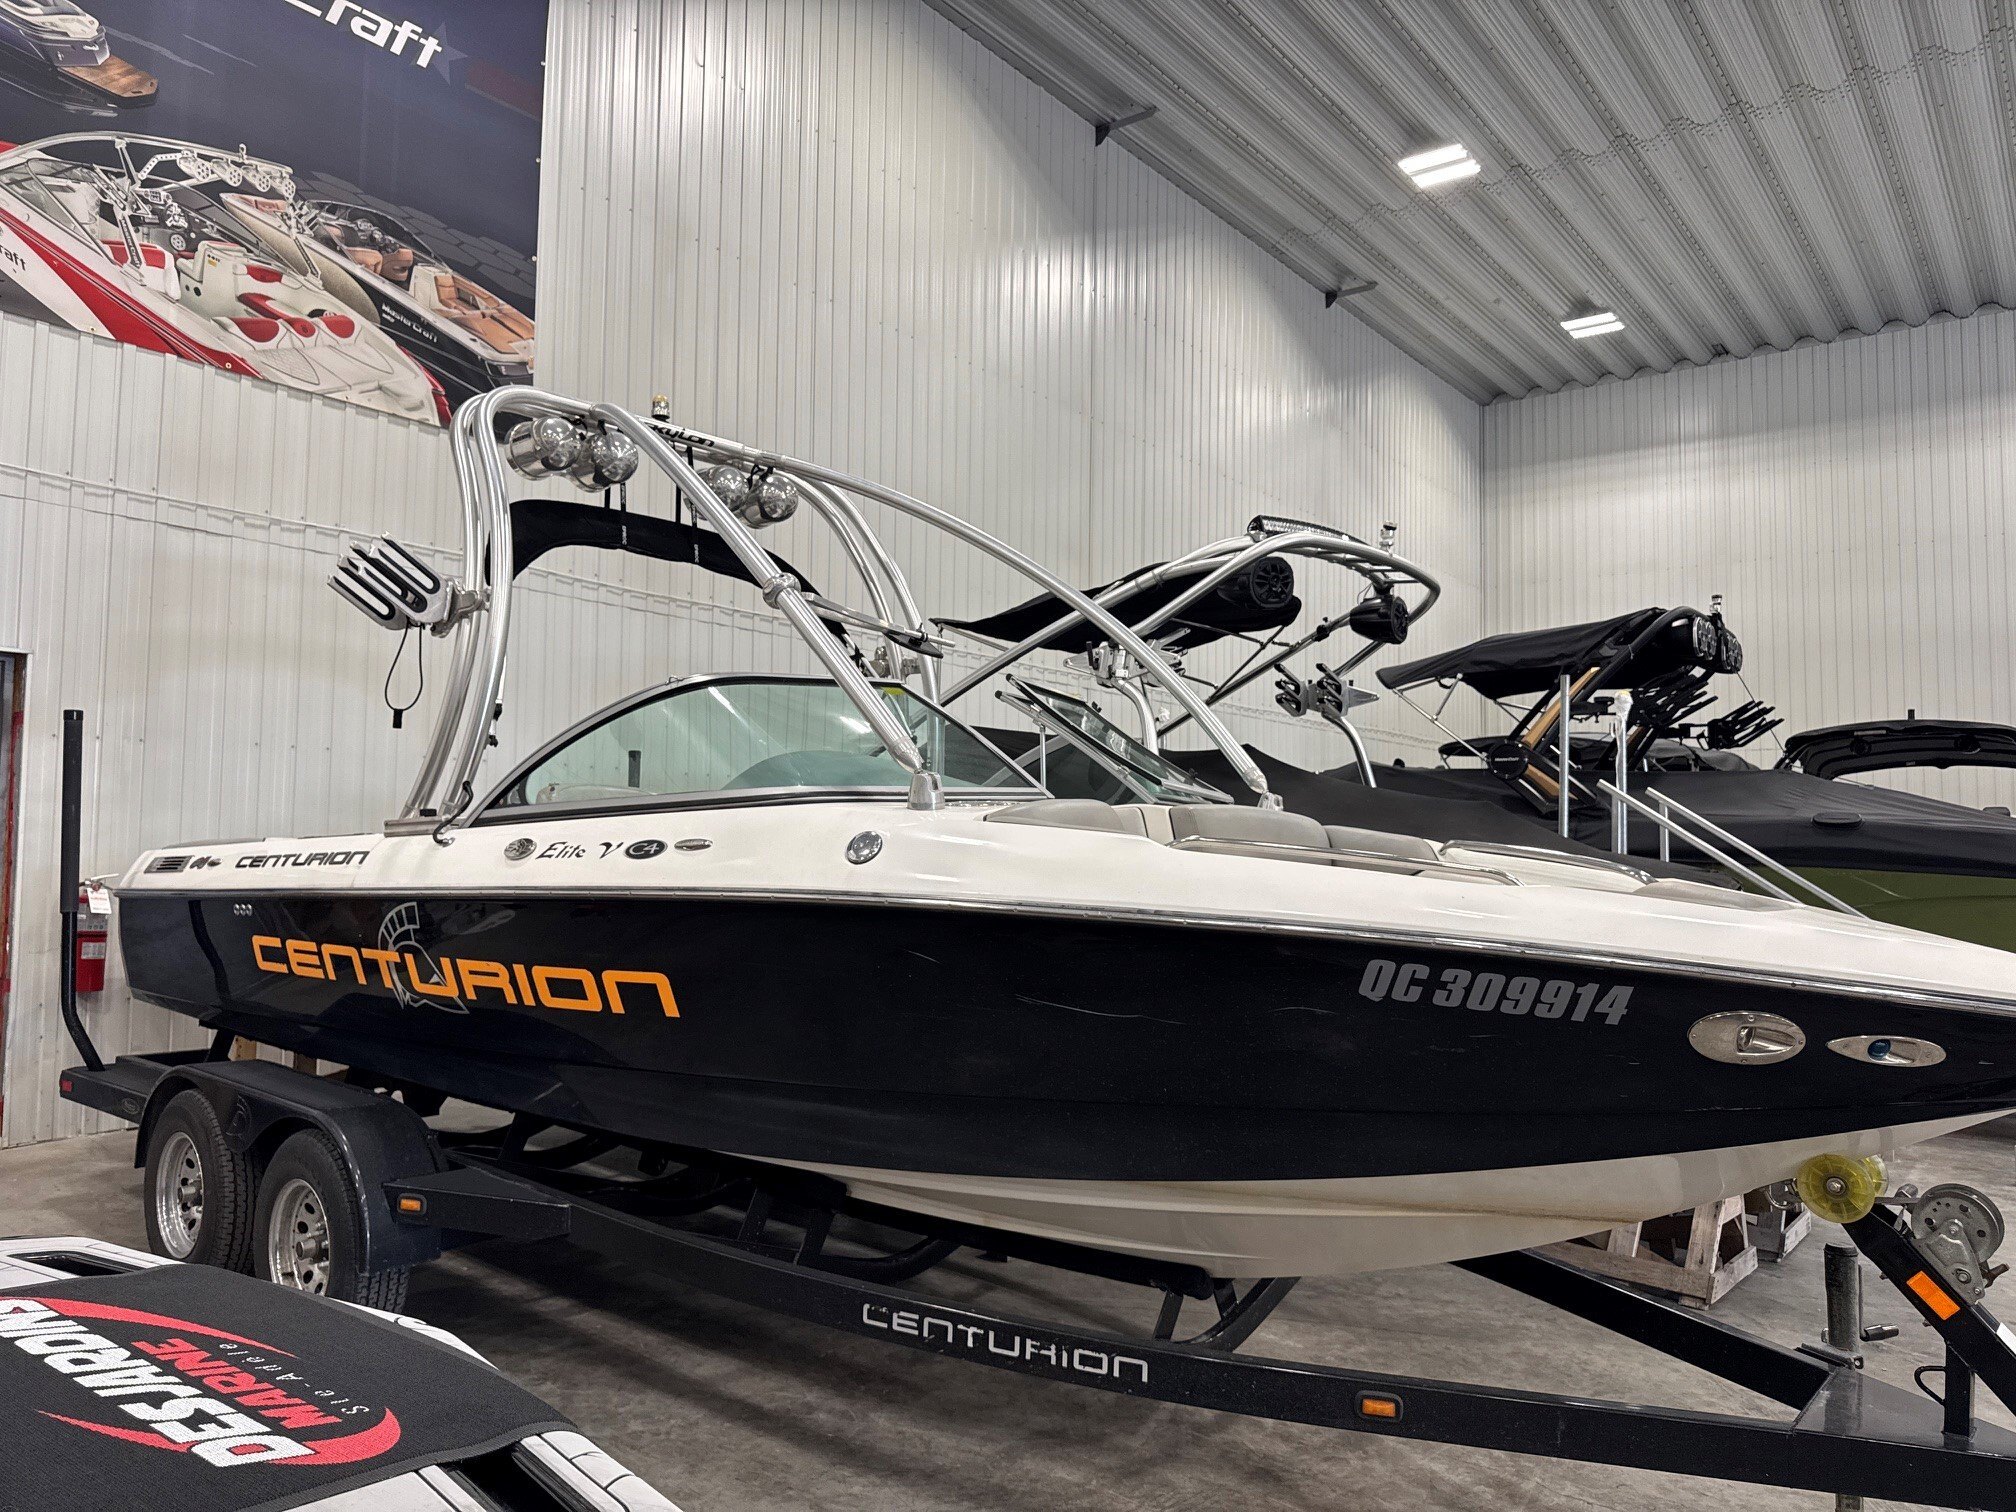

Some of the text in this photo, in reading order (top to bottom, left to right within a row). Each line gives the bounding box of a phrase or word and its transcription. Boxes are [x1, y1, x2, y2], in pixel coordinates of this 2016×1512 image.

[285, 0, 443, 69] raft
[234, 850, 371, 869] CENTURION
[535, 841, 587, 860] Elite
[598, 841, 625, 860] V
[251, 934, 681, 1018] CENTURION
[1358, 958, 1635, 1026] QC 309914
[862, 1303, 1149, 1383] CENTURION
[132, 1337, 343, 1429] MARINE
